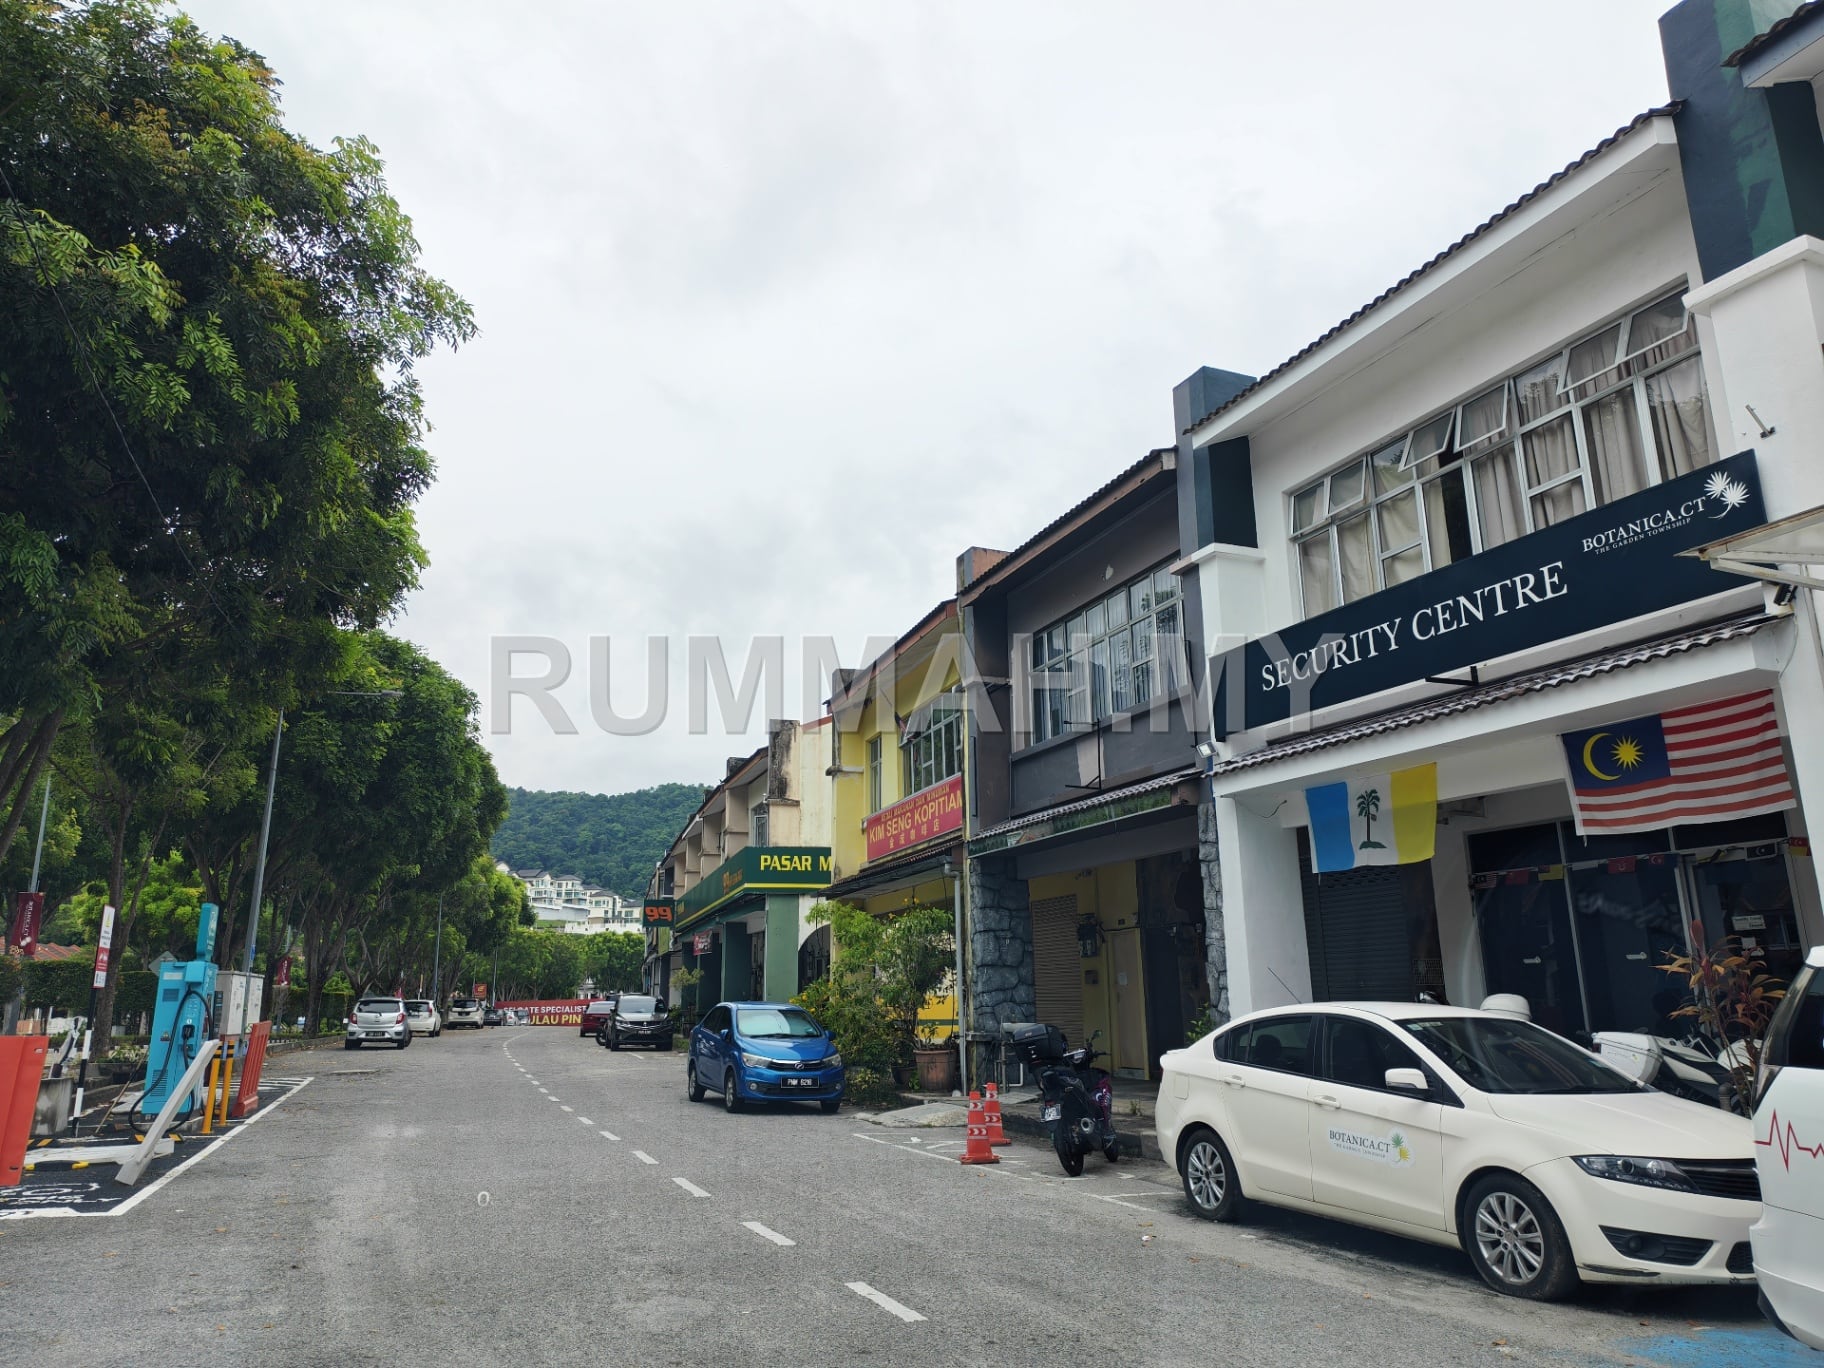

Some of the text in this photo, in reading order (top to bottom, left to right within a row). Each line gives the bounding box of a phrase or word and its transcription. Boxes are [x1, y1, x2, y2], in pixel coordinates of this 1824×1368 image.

[1582, 496, 1706, 553] BOTANICA.CT
[1595, 518, 1691, 555] THE GARDEN TOWNSHIP
[1261, 560, 1568, 692] SECURITY CENTRE
[869, 823, 885, 844] KIM
[886, 812, 912, 837] SENG
[760, 855, 812, 871] PASAR
[645, 906, 673, 922] 99
[1329, 1130, 1391, 1153] BOTANICA.CT
